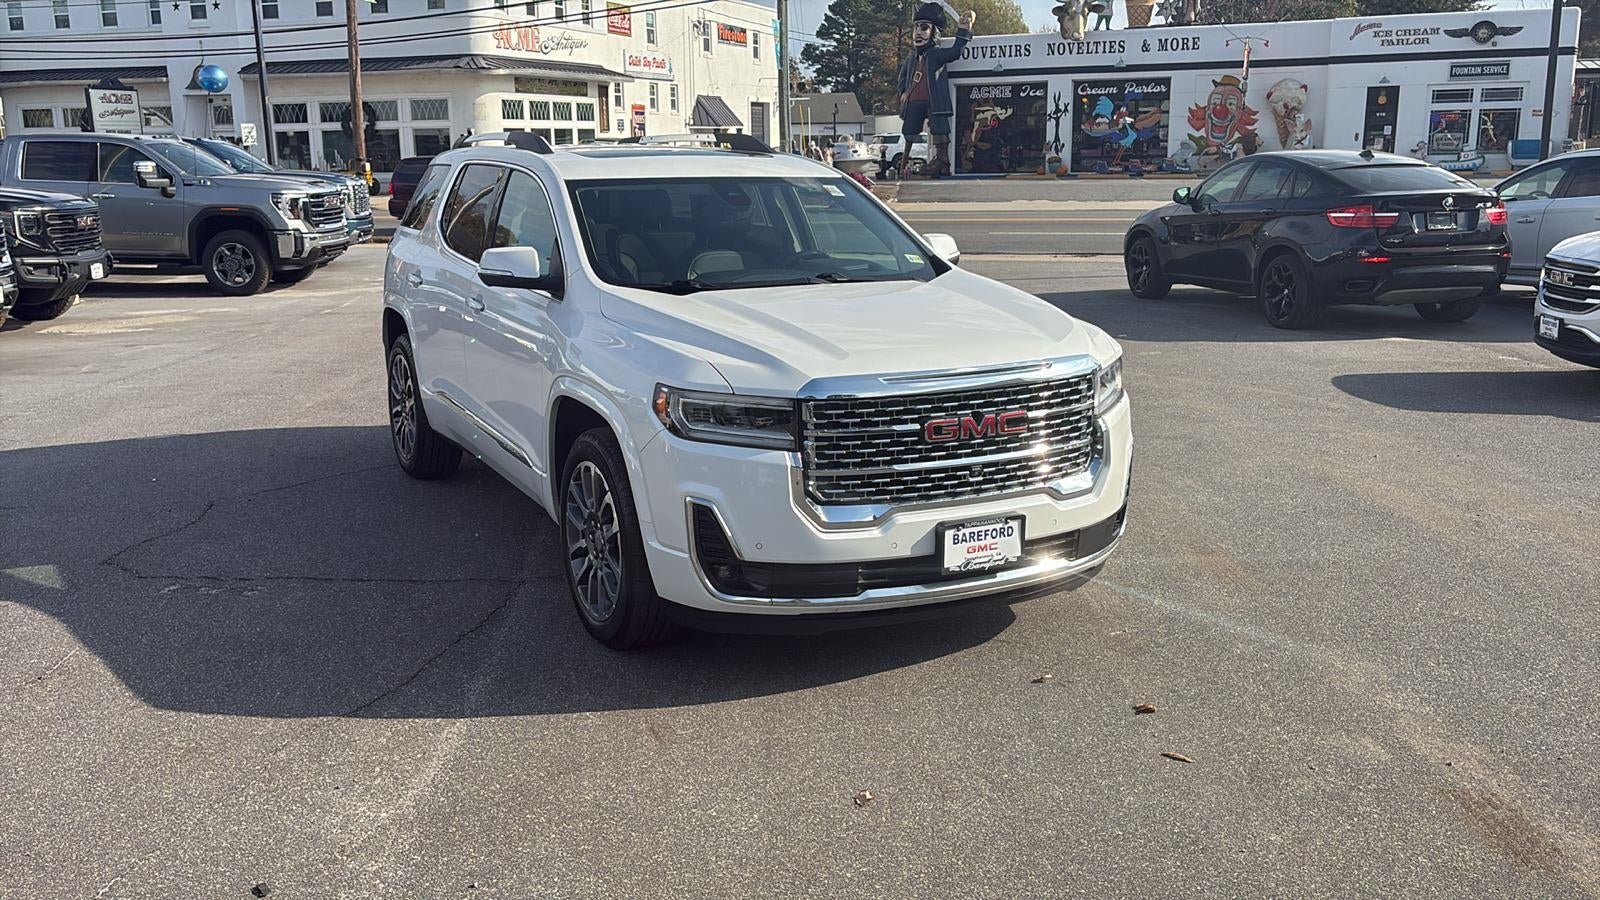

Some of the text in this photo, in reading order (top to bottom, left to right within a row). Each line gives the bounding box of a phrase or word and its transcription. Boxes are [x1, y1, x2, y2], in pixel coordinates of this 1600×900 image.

[493, 21, 589, 56] ACME Antiques
[1372, 27, 1441, 38] ICE CREAM
[962, 36, 1200, 60] OUVENIRS NOVELTIES & MORE
[1380, 37, 1431, 46] PARLOR
[1452, 64, 1508, 75] FOUNTAIN SERVICE
[969, 85, 1045, 99] ACME Ice
[1077, 81, 1168, 95] Cream Parlor
[244, 134, 256, 143] 25
[924, 410, 1028, 443] GMC
[952, 525, 1014, 546] BAREFORD
[966, 542, 999, 554] GMC
[961, 555, 1009, 571] Bareford
